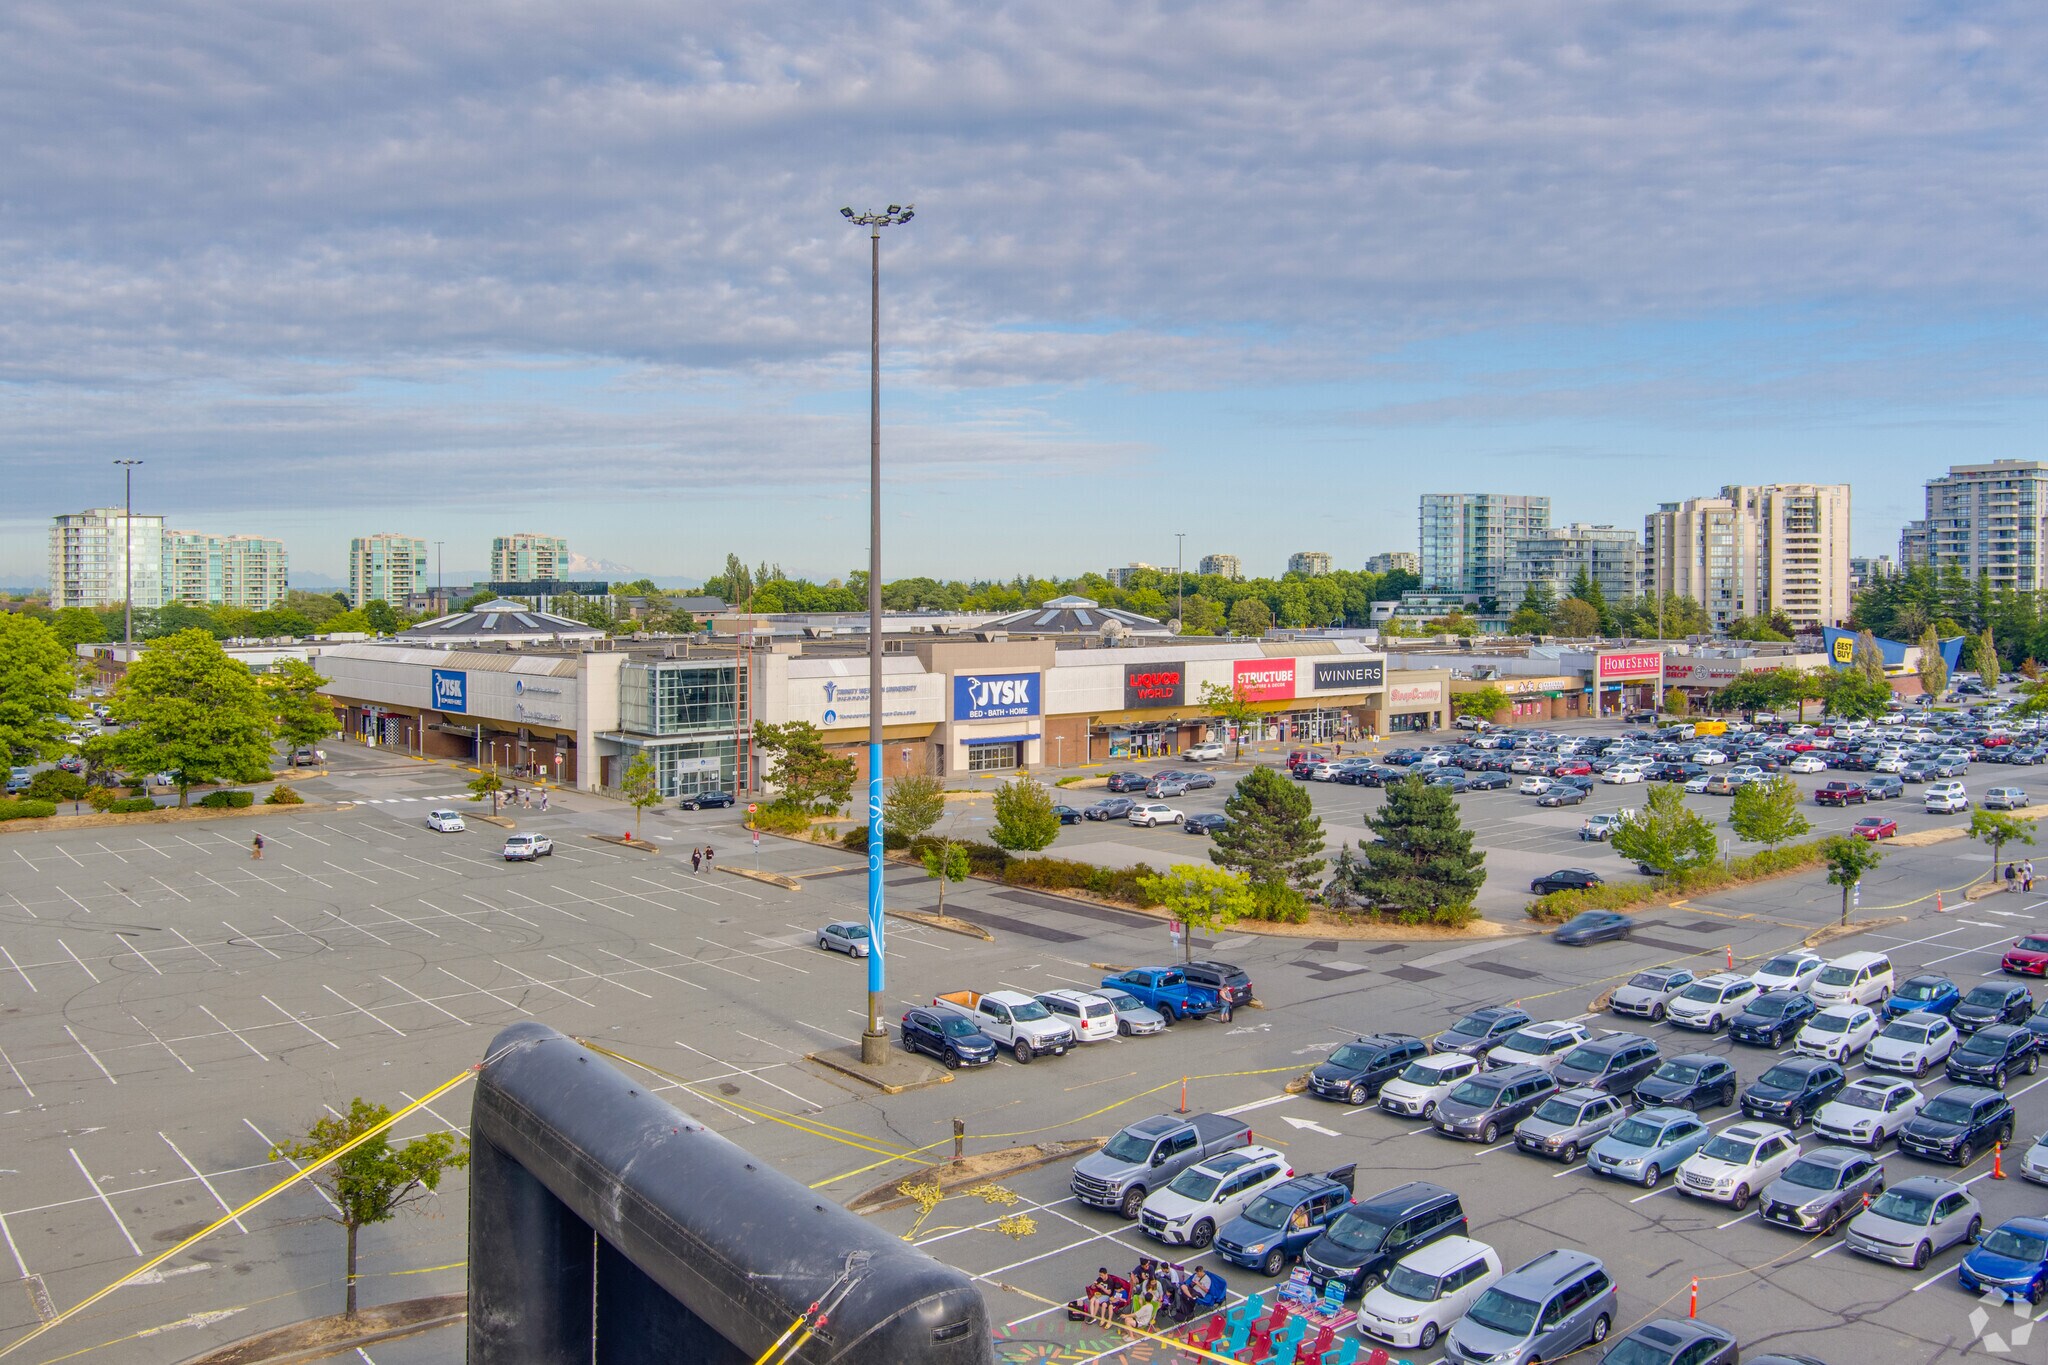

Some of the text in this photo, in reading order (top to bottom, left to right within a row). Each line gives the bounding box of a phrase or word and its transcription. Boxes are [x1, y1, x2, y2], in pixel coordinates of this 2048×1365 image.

[1837, 642, 1852, 650] BEST
[1237, 670, 1293, 684] STRUCTUBE
[1319, 668, 1381, 682] WINNERS
[440, 679, 462, 697] JYSK
[976, 679, 1029, 707] JYSK
[1138, 687, 1174, 699] WORLD
[969, 707, 1028, 718] BED BATH HOME
